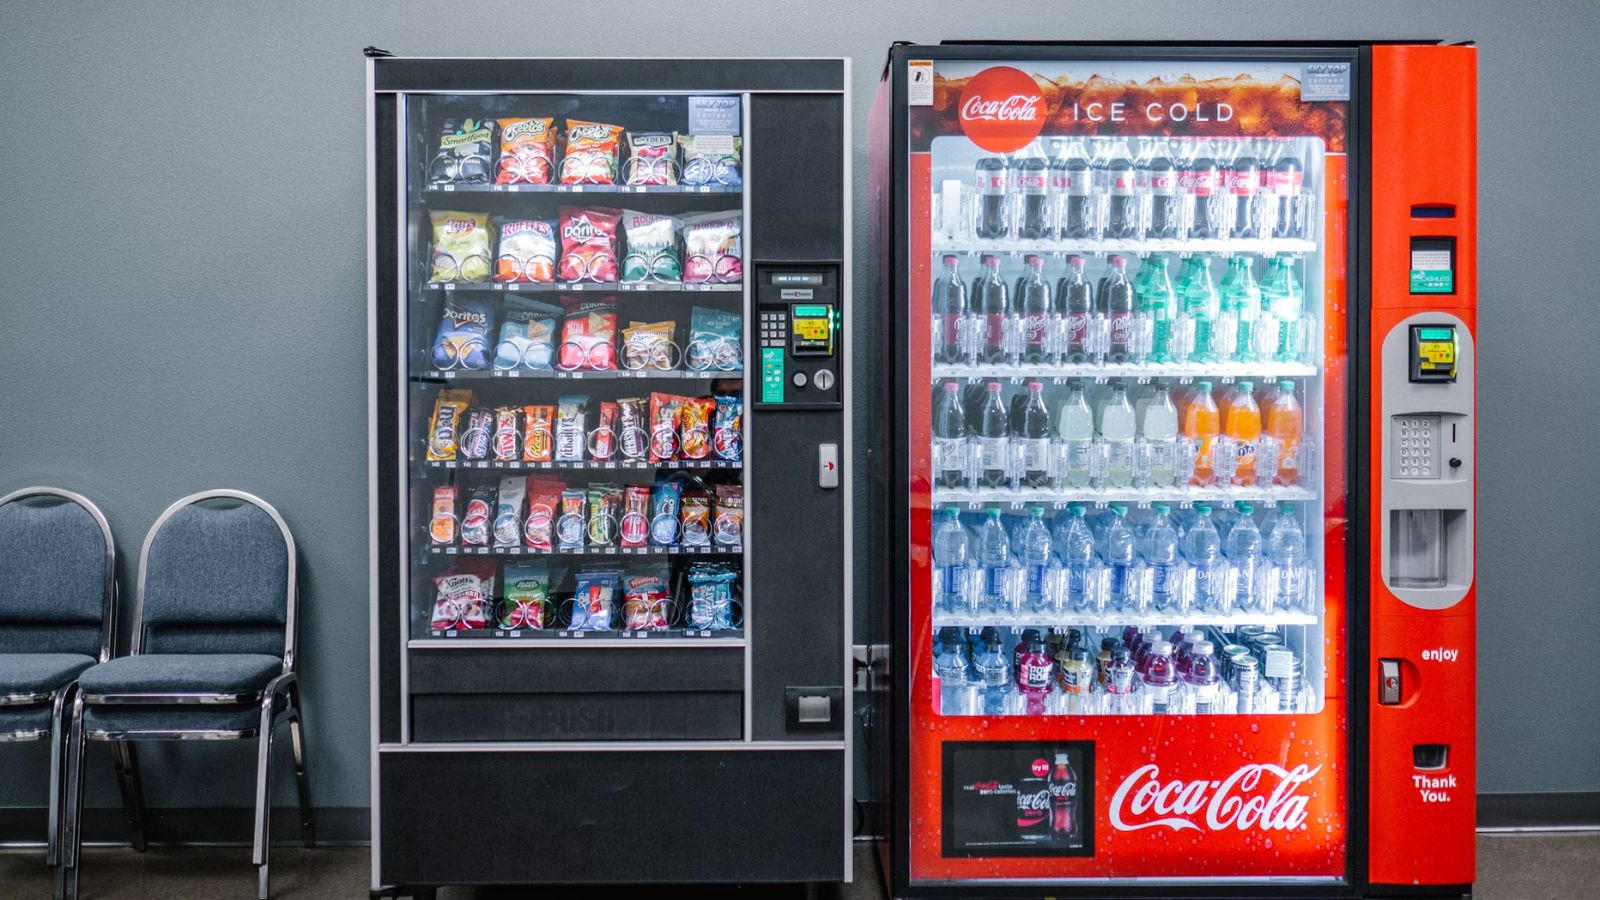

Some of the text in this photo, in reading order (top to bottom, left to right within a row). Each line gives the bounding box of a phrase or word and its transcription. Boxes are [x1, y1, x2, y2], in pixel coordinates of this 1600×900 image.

[962, 95, 1041, 121] Coca-Cola
[1073, 103, 1234, 122] ICE COLD
[443, 131, 490, 146] Smartfood
[504, 121, 546, 143] Cheetos
[568, 125, 611, 143] Cheetos
[445, 219, 476, 232] Lay's
[503, 220, 549, 236] RUFFLES
[442, 308, 487, 323] Doritos
[501, 418, 514, 455] TWIX
[1238, 444, 1255, 456] nta
[1421, 648, 1458, 662] enjoy
[1412, 775, 1457, 788] Thank
[1109, 763, 1323, 832] Coca-Cola
[1420, 789, 1450, 803] You.
